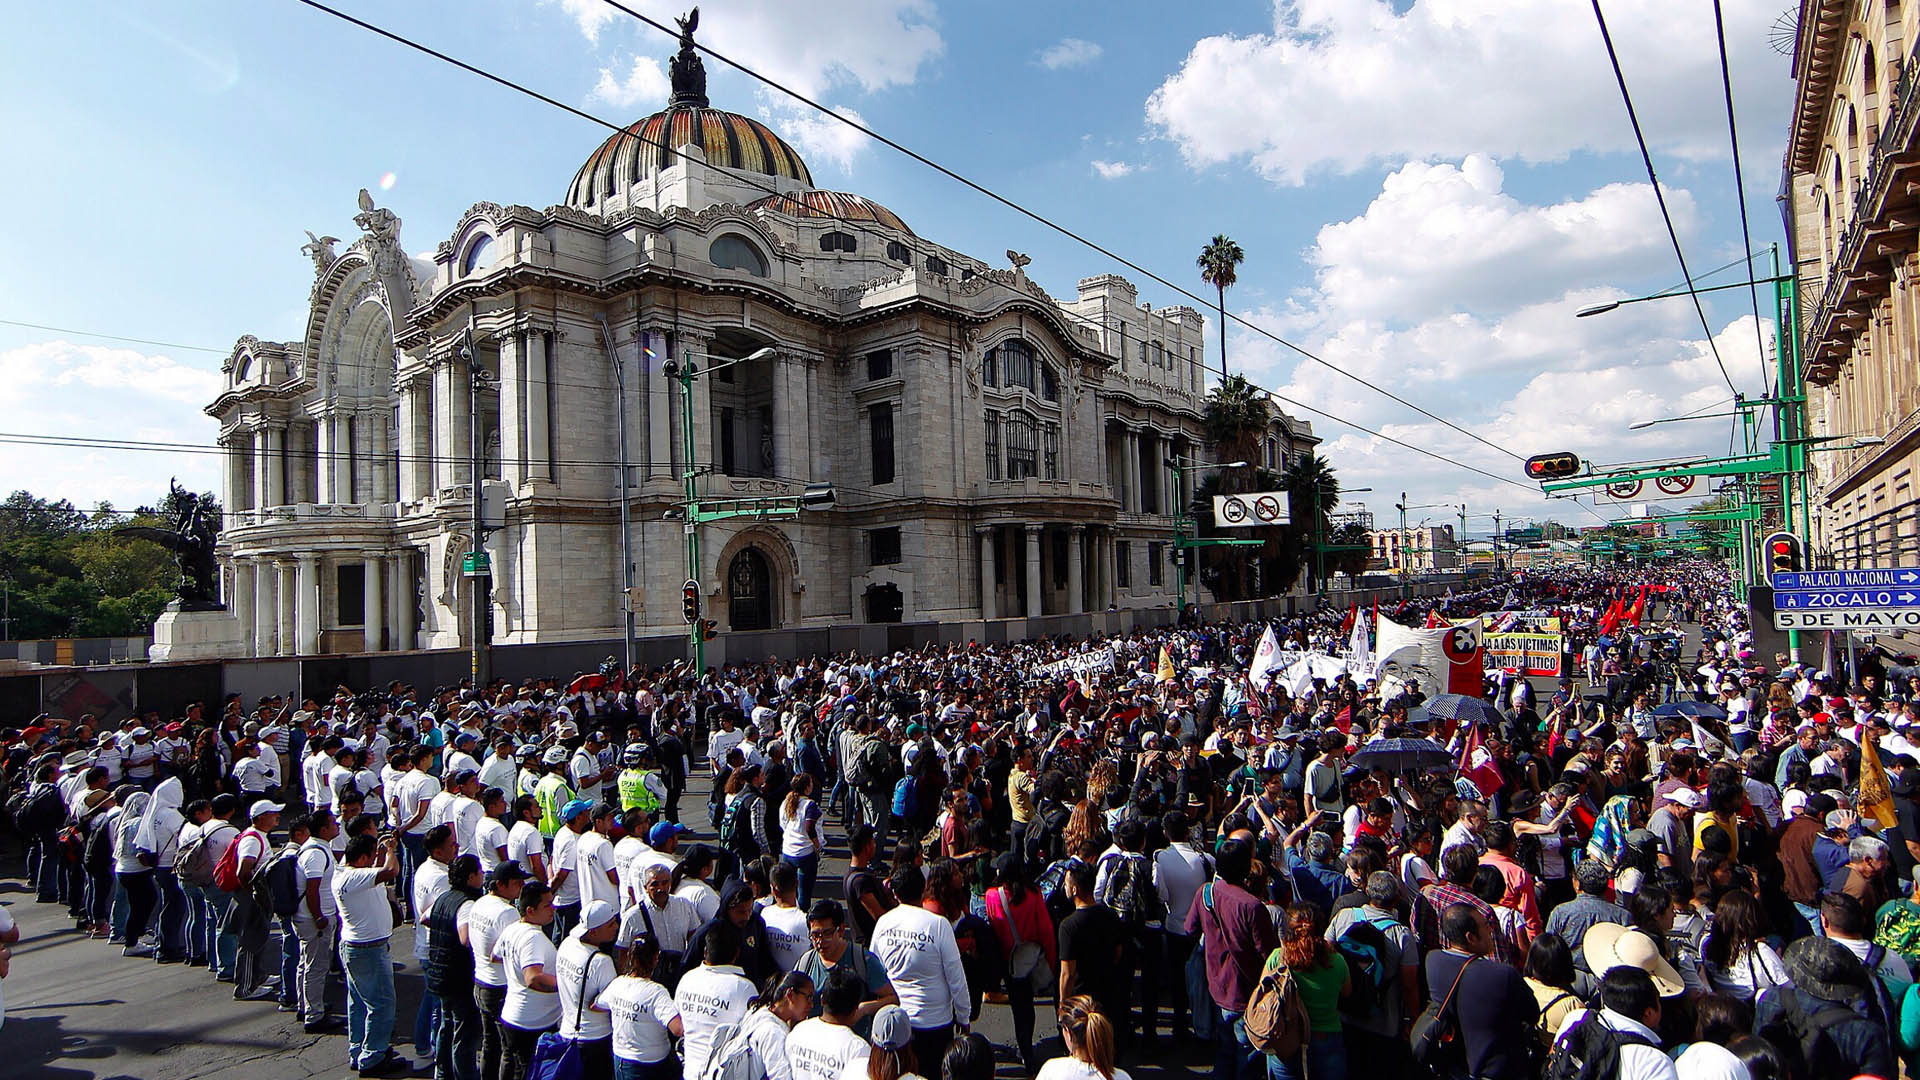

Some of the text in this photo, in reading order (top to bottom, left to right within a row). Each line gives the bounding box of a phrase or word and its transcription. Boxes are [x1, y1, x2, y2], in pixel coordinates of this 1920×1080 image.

[1799, 571, 1897, 587] PALACIO NACIONAL
[1807, 592, 1891, 607] ZOCALO
[1780, 612, 1920, 626] 5 DE MAYO
[1501, 638, 1516, 650] LAS
[1516, 638, 1559, 652] VICTIMAS
[1517, 654, 1556, 670] POLITICO
[903, 940, 926, 951] PAZ
[622, 1011, 638, 1022] PAZ
[682, 1002, 718, 1018] DE PAZ
[796, 1058, 835, 1080] DE PAZ
